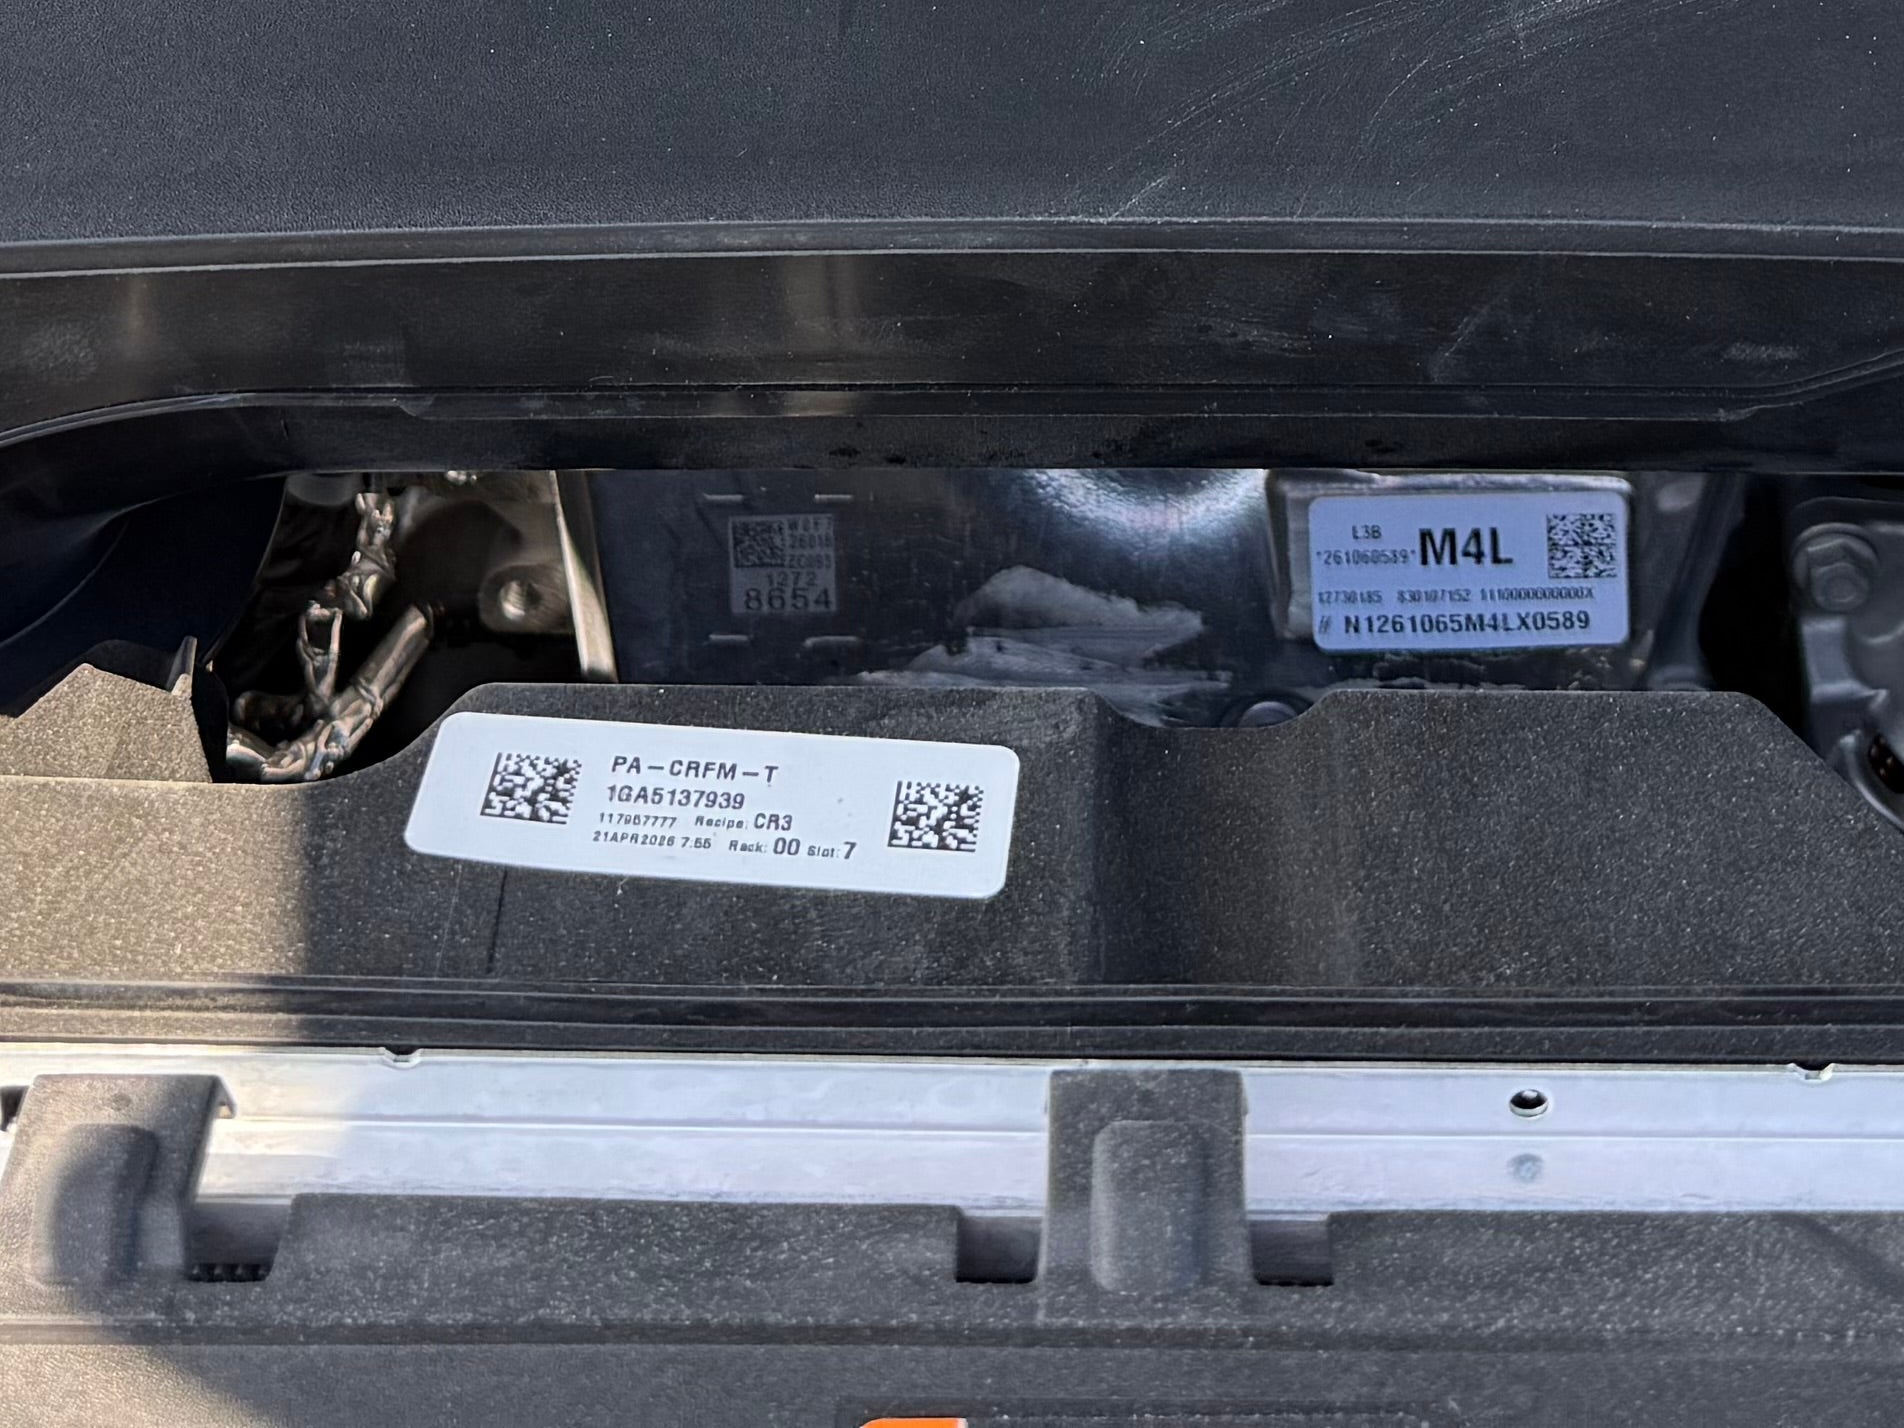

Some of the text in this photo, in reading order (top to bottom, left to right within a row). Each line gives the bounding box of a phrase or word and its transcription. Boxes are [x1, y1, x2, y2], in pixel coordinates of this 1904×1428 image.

[1351, 525, 1382, 540] L3B
[1419, 526, 1514, 566] M4L
[744, 587, 831, 610] 8654
[1344, 610, 1591, 634] N1261065M4LX0589
[607, 784, 746, 810] 1GA5137939
[753, 813, 794, 832] CR3
[773, 838, 801, 855] 00
[843, 841, 857, 860] 7
